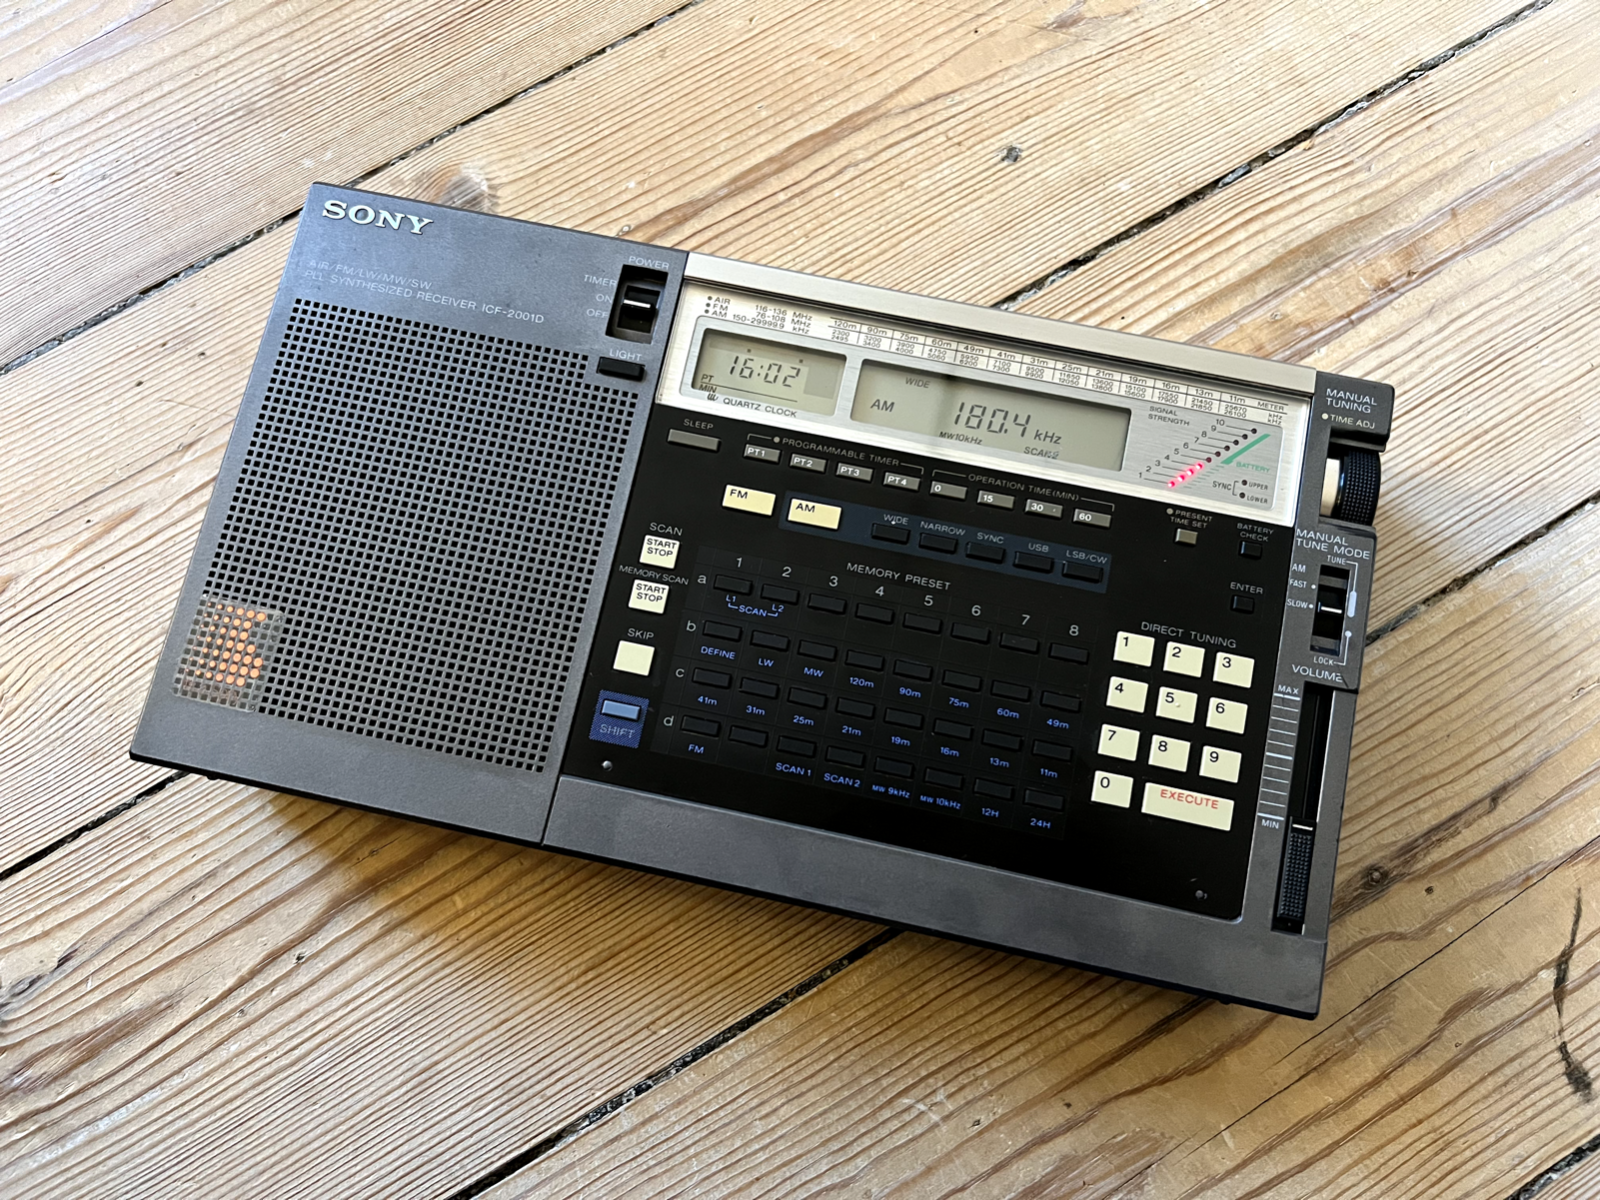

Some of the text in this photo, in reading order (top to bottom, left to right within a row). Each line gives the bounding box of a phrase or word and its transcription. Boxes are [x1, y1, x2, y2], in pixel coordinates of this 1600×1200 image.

[322, 199, 433, 235] SONY
[628, 256, 669, 269] POWER
[309, 259, 432, 290] AIR/FM/LW/MW/SW
[584, 275, 617, 286] TIMER
[304, 270, 545, 324] PLL SYNTHESIZED RECEIVER ICF-2001D
[596, 294, 612, 303] ON
[587, 309, 608, 318] OFF
[714, 297, 812, 321] AIR 116-136 MHz
[712, 310, 727, 318] AM
[792, 326, 810, 334] kHz
[756, 312, 786, 322] 76-108
[791, 319, 811, 328] MHz
[834, 320, 857, 329] 120m
[867, 327, 887, 335] 90m
[900, 333, 918, 342] 75m
[932, 339, 952, 348] 60m
[609, 349, 642, 361] LIGHT
[963, 345, 984, 354] 49m
[997, 351, 1016, 360] 41m
[1030, 357, 1048, 366] 31m
[730, 356, 800, 387] 16:02
[1062, 364, 1082, 372] 25m
[701, 374, 713, 382] PT
[1096, 370, 1114, 379] 21m
[906, 377, 929, 389] WIDE
[1129, 376, 1147, 385] 19m
[1162, 382, 1180, 391] 16m
[1195, 388, 1213, 397] 13m
[1326, 388, 1377, 405] MANUAL
[1229, 395, 1245, 404] 11m
[723, 397, 797, 417] QUARTZ CLOCK
[870, 399, 895, 412] AM
[1150, 406, 1178, 416] SIGNAL
[1257, 401, 1284, 411] METER
[1326, 398, 1371, 413] TUNING
[683, 419, 713, 429] SLEEP
[954, 402, 1062, 445] 180.4 kHz
[1148, 414, 1190, 426] STRENGTH
[1330, 414, 1375, 429] TIME ADJ
[747, 448, 766, 457] PT1
[782, 438, 899, 466] PROGRAMMABLE TIMER
[794, 457, 812, 467] PT2
[1236, 461, 1270, 473] BATTERY
[840, 467, 860, 477] PT3
[887, 476, 907, 486] PT4
[1212, 481, 1232, 491] SYNC
[1249, 481, 1268, 490] UPPER
[934, 485, 941, 493] 0
[968, 474, 1080, 501] OPERATION TIME(MIN)
[729, 489, 748, 499] FM
[983, 495, 993, 503] 15
[1247, 495, 1268, 504] LOWER
[796, 503, 815, 513] AM
[1031, 504, 1044, 512] 30
[883, 514, 909, 525] WIDE
[1079, 513, 1092, 521] 60
[1170, 517, 1188, 525] TIME
[1175, 510, 1212, 522] PRESENT
[650, 522, 683, 536] SCAN
[920, 521, 965, 536] NARROW
[1237, 523, 1274, 534] BATTERY
[977, 532, 1004, 544] SYNC
[1240, 532, 1268, 542] CHECK
[1296, 529, 1349, 545] MANUAL
[647, 538, 677, 549] START
[1028, 542, 1049, 553] USB
[1296, 538, 1370, 560] TUNE MODE
[647, 547, 673, 557] STOP
[1066, 550, 1107, 564] LSB/CW
[736, 557, 743, 567] 1
[1327, 555, 1346, 565] TUNE
[781, 566, 792, 577] 2
[1292, 564, 1305, 572] AM
[619, 565, 689, 585] MEMORY SCAN
[698, 575, 707, 584] a
[846, 562, 950, 590] MEMORY PRESET
[829, 576, 838, 586] 3
[1290, 579, 1307, 588] FAST
[636, 583, 666, 595] START
[876, 586, 884, 596] 4
[1230, 582, 1264, 594] ENTER
[636, 592, 663, 602] STOP
[924, 595, 933, 606] 5
[1287, 599, 1308, 608] SLOW
[738, 605, 767, 617] SCAN
[972, 605, 981, 616] 6
[1021, 614, 1030, 625] 7
[686, 620, 696, 632] b
[1069, 625, 1079, 636] 8
[627, 628, 654, 640] SKIP
[1141, 622, 1236, 648] DIRECT TUNING
[1123, 637, 1129, 647] 1
[701, 646, 736, 659] DEFINE
[1172, 647, 1181, 657] 2
[758, 658, 774, 667] LW
[1222, 657, 1231, 668] 3
[1314, 656, 1334, 666] LOCK
[804, 668, 824, 677] MW
[1292, 664, 1343, 682] VOLUME
[850, 676, 874, 688] 120m
[899, 687, 921, 698] 90m
[1115, 683, 1124, 693] 4
[1278, 685, 1299, 694] MAX
[697, 696, 718, 705] 41m
[949, 697, 969, 708] 75m
[1165, 692, 1174, 703] 5
[746, 705, 765, 715] 31m
[997, 708, 1019, 719] 60m
[1215, 703, 1225, 714] 6
[663, 715, 674, 726] d
[793, 715, 814, 726] 25m
[1046, 718, 1069, 730] 49m
[600, 724, 635, 738] SHIFT
[842, 726, 862, 736] 21m
[1108, 730, 1116, 740] 7
[891, 736, 910, 747] 19m
[1158, 741, 1168, 752] 8
[688, 744, 704, 753] FM
[940, 746, 960, 758] 16m
[1209, 751, 1219, 762] 9
[990, 757, 1010, 768] 13m
[776, 763, 804, 775] SCAN
[1040, 768, 1058, 778] 11m
[824, 772, 860, 788] SCAN 2
[1100, 777, 1110, 788] 0
[1160, 789, 1219, 809] EXECUTE
[982, 808, 999, 818] 12H
[1030, 818, 1050, 829] 24H
[1261, 820, 1279, 829] MIN
